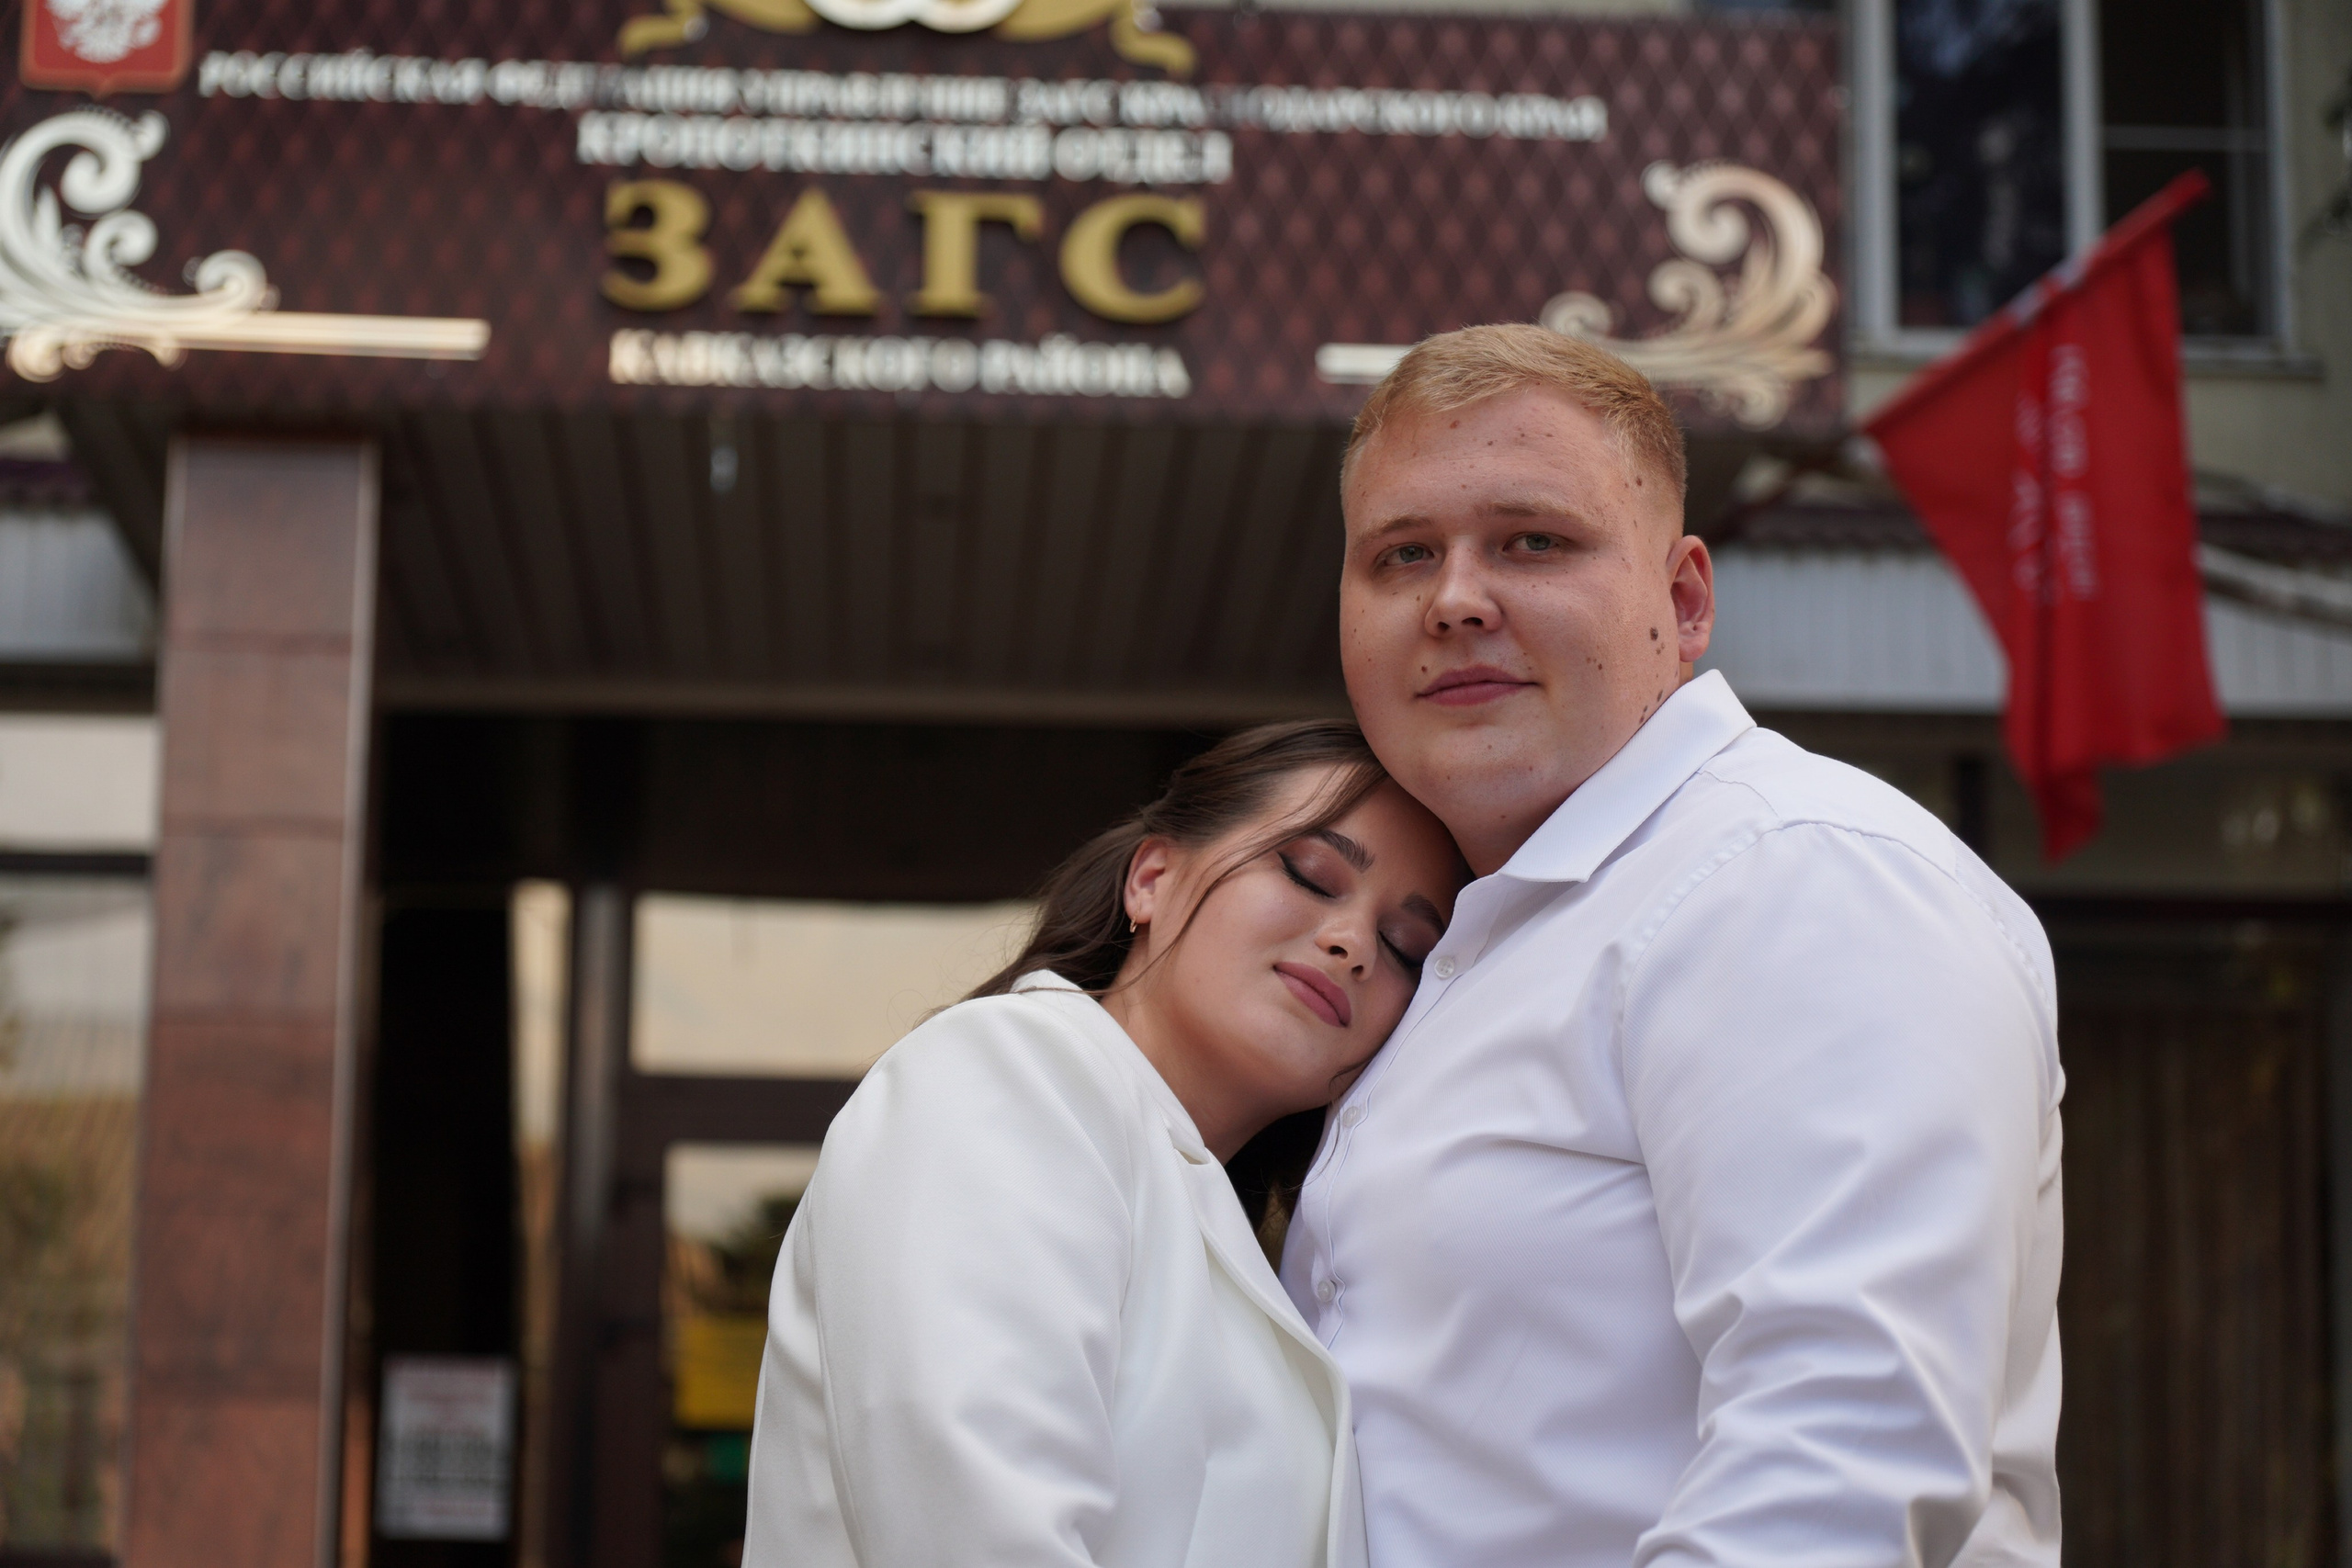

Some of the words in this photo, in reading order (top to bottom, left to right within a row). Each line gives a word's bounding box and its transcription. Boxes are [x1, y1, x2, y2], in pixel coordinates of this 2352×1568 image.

[1051, 125, 1233, 186] ОТДЕЛ
[601, 180, 1205, 325] ЗАГС
[609, 328, 978, 394] КАВКАЗСКОГО
[979, 333, 1190, 399] РАЙОНА
